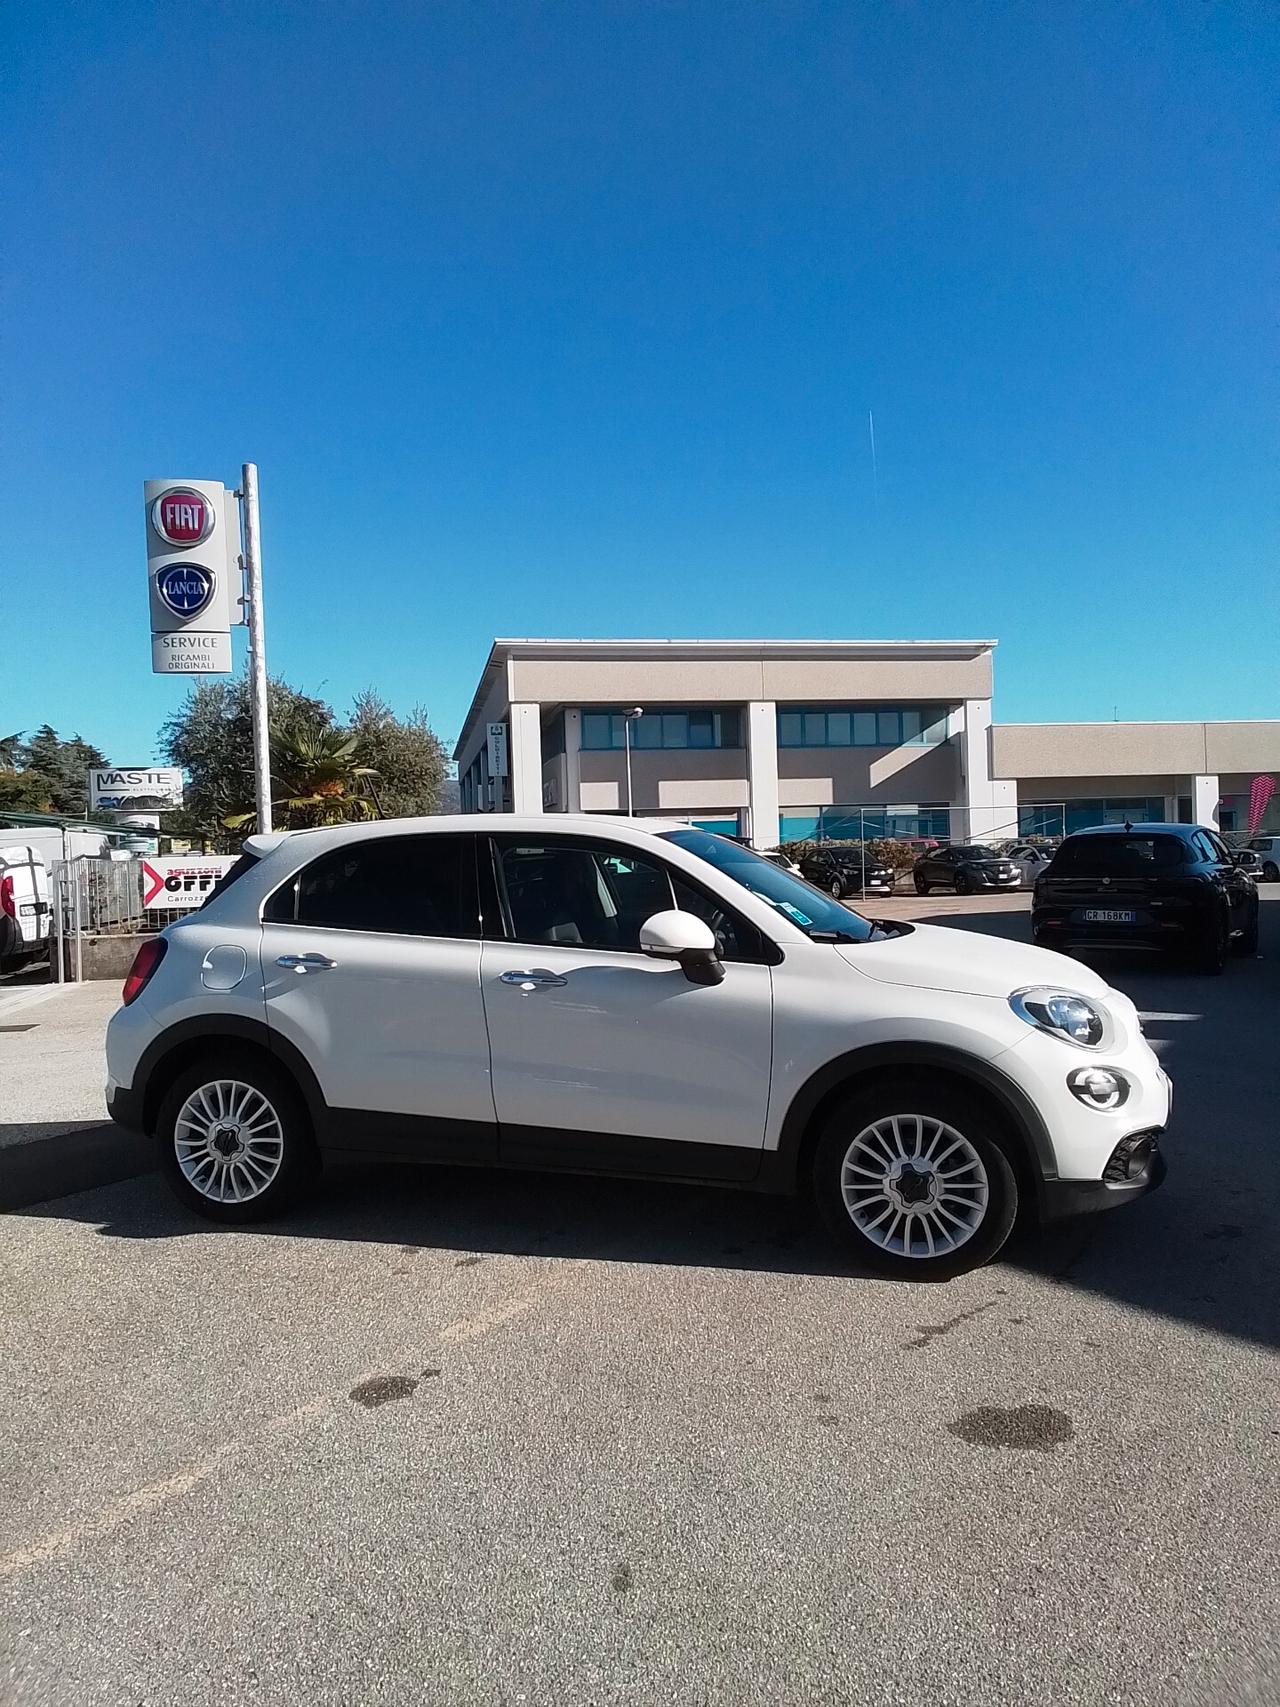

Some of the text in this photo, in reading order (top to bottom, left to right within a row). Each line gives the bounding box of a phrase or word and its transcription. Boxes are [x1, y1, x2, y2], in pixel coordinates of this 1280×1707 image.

[166, 503, 201, 530] FIAT
[168, 581, 204, 595] LANCIA
[163, 637, 218, 648] SERVICE
[171, 654, 210, 662] RICAMBI
[168, 662, 215, 670] ORIGINALI
